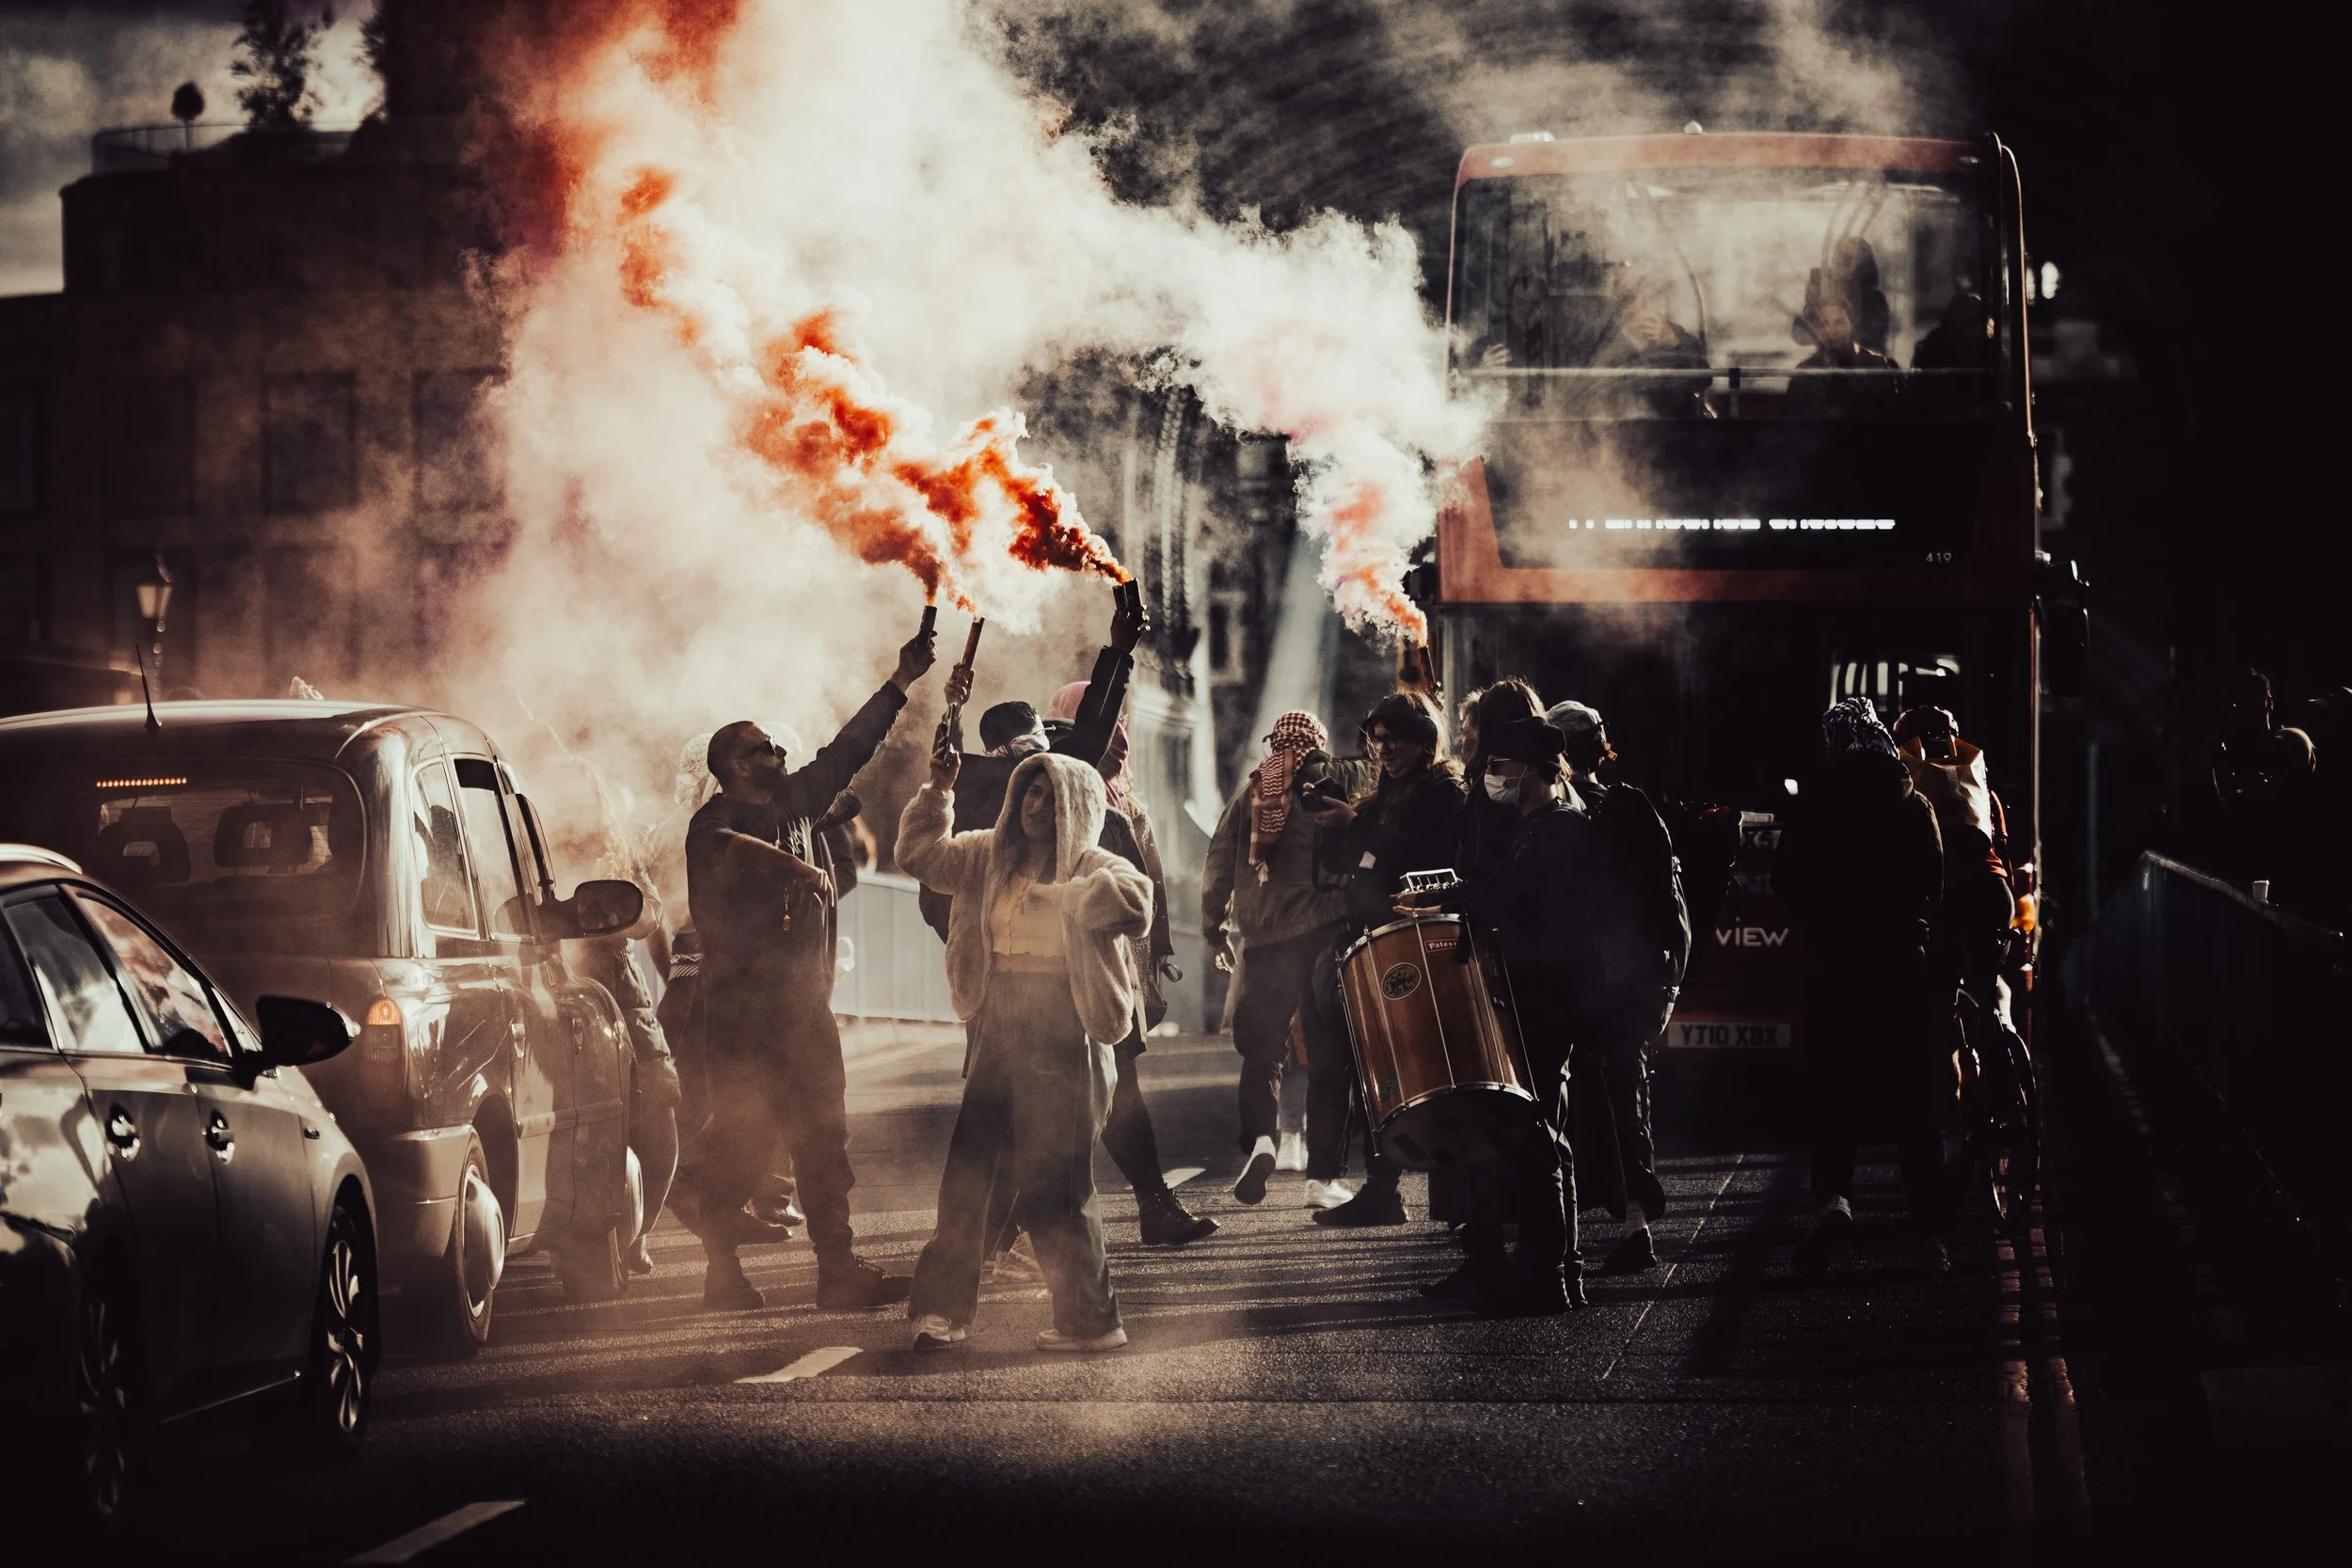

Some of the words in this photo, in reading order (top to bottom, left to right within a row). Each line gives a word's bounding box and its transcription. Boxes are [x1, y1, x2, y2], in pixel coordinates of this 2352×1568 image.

[1925, 551, 1953, 564] 419
[1428, 941, 1458, 950] Palest
[1680, 1024, 1729, 1045] YT10
